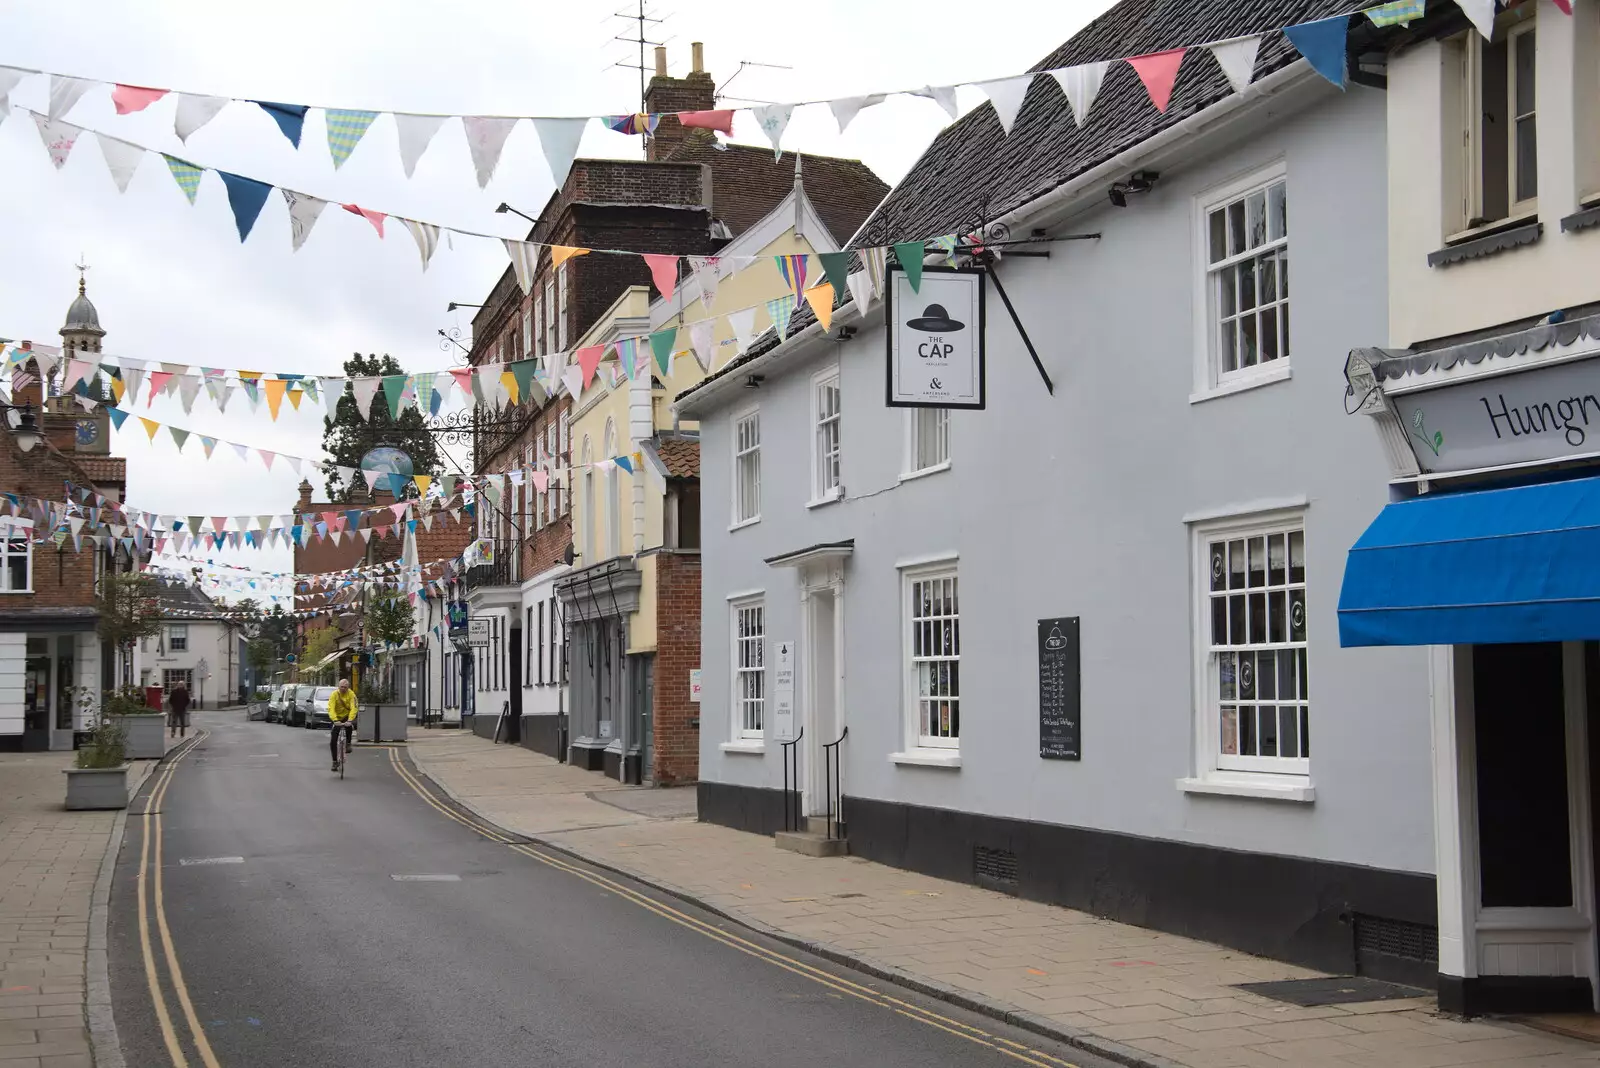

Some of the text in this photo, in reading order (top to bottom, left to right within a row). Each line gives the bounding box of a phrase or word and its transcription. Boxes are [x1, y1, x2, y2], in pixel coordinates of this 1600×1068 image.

[918, 343, 954, 359] CAP
[930, 377, 943, 389] &
[1480, 394, 1600, 446] Hungr
